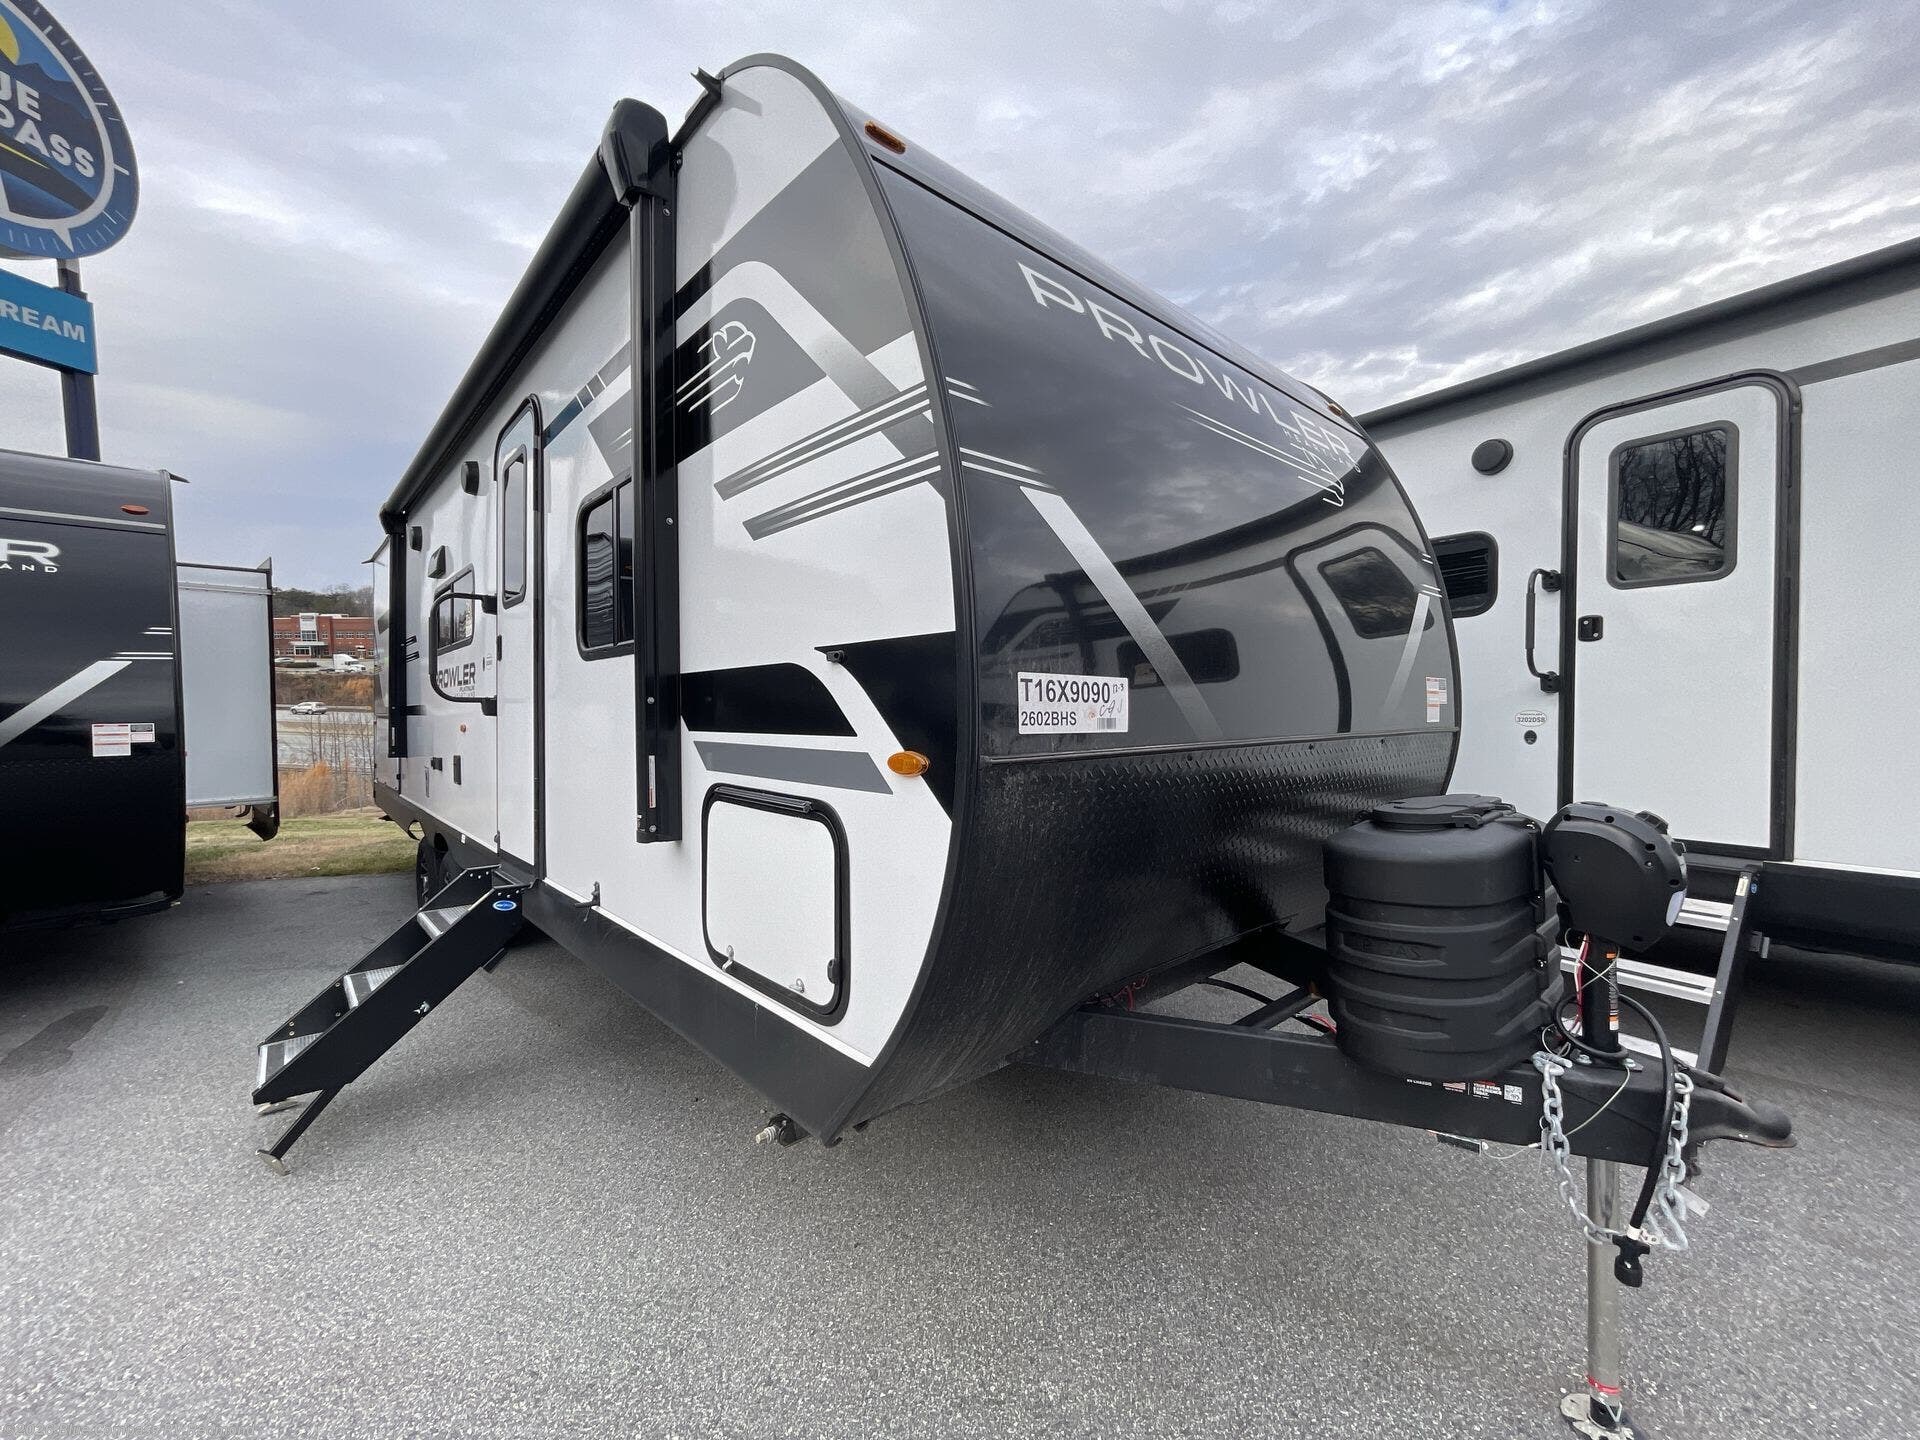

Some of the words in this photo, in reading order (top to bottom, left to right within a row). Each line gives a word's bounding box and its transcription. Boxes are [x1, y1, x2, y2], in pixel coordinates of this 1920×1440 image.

[1017, 261, 1355, 465] PROWLER
[436, 662, 475, 688] ROWLER
[1020, 678, 1111, 704] T16X9090
[1021, 711, 1077, 726] 2602BHS
